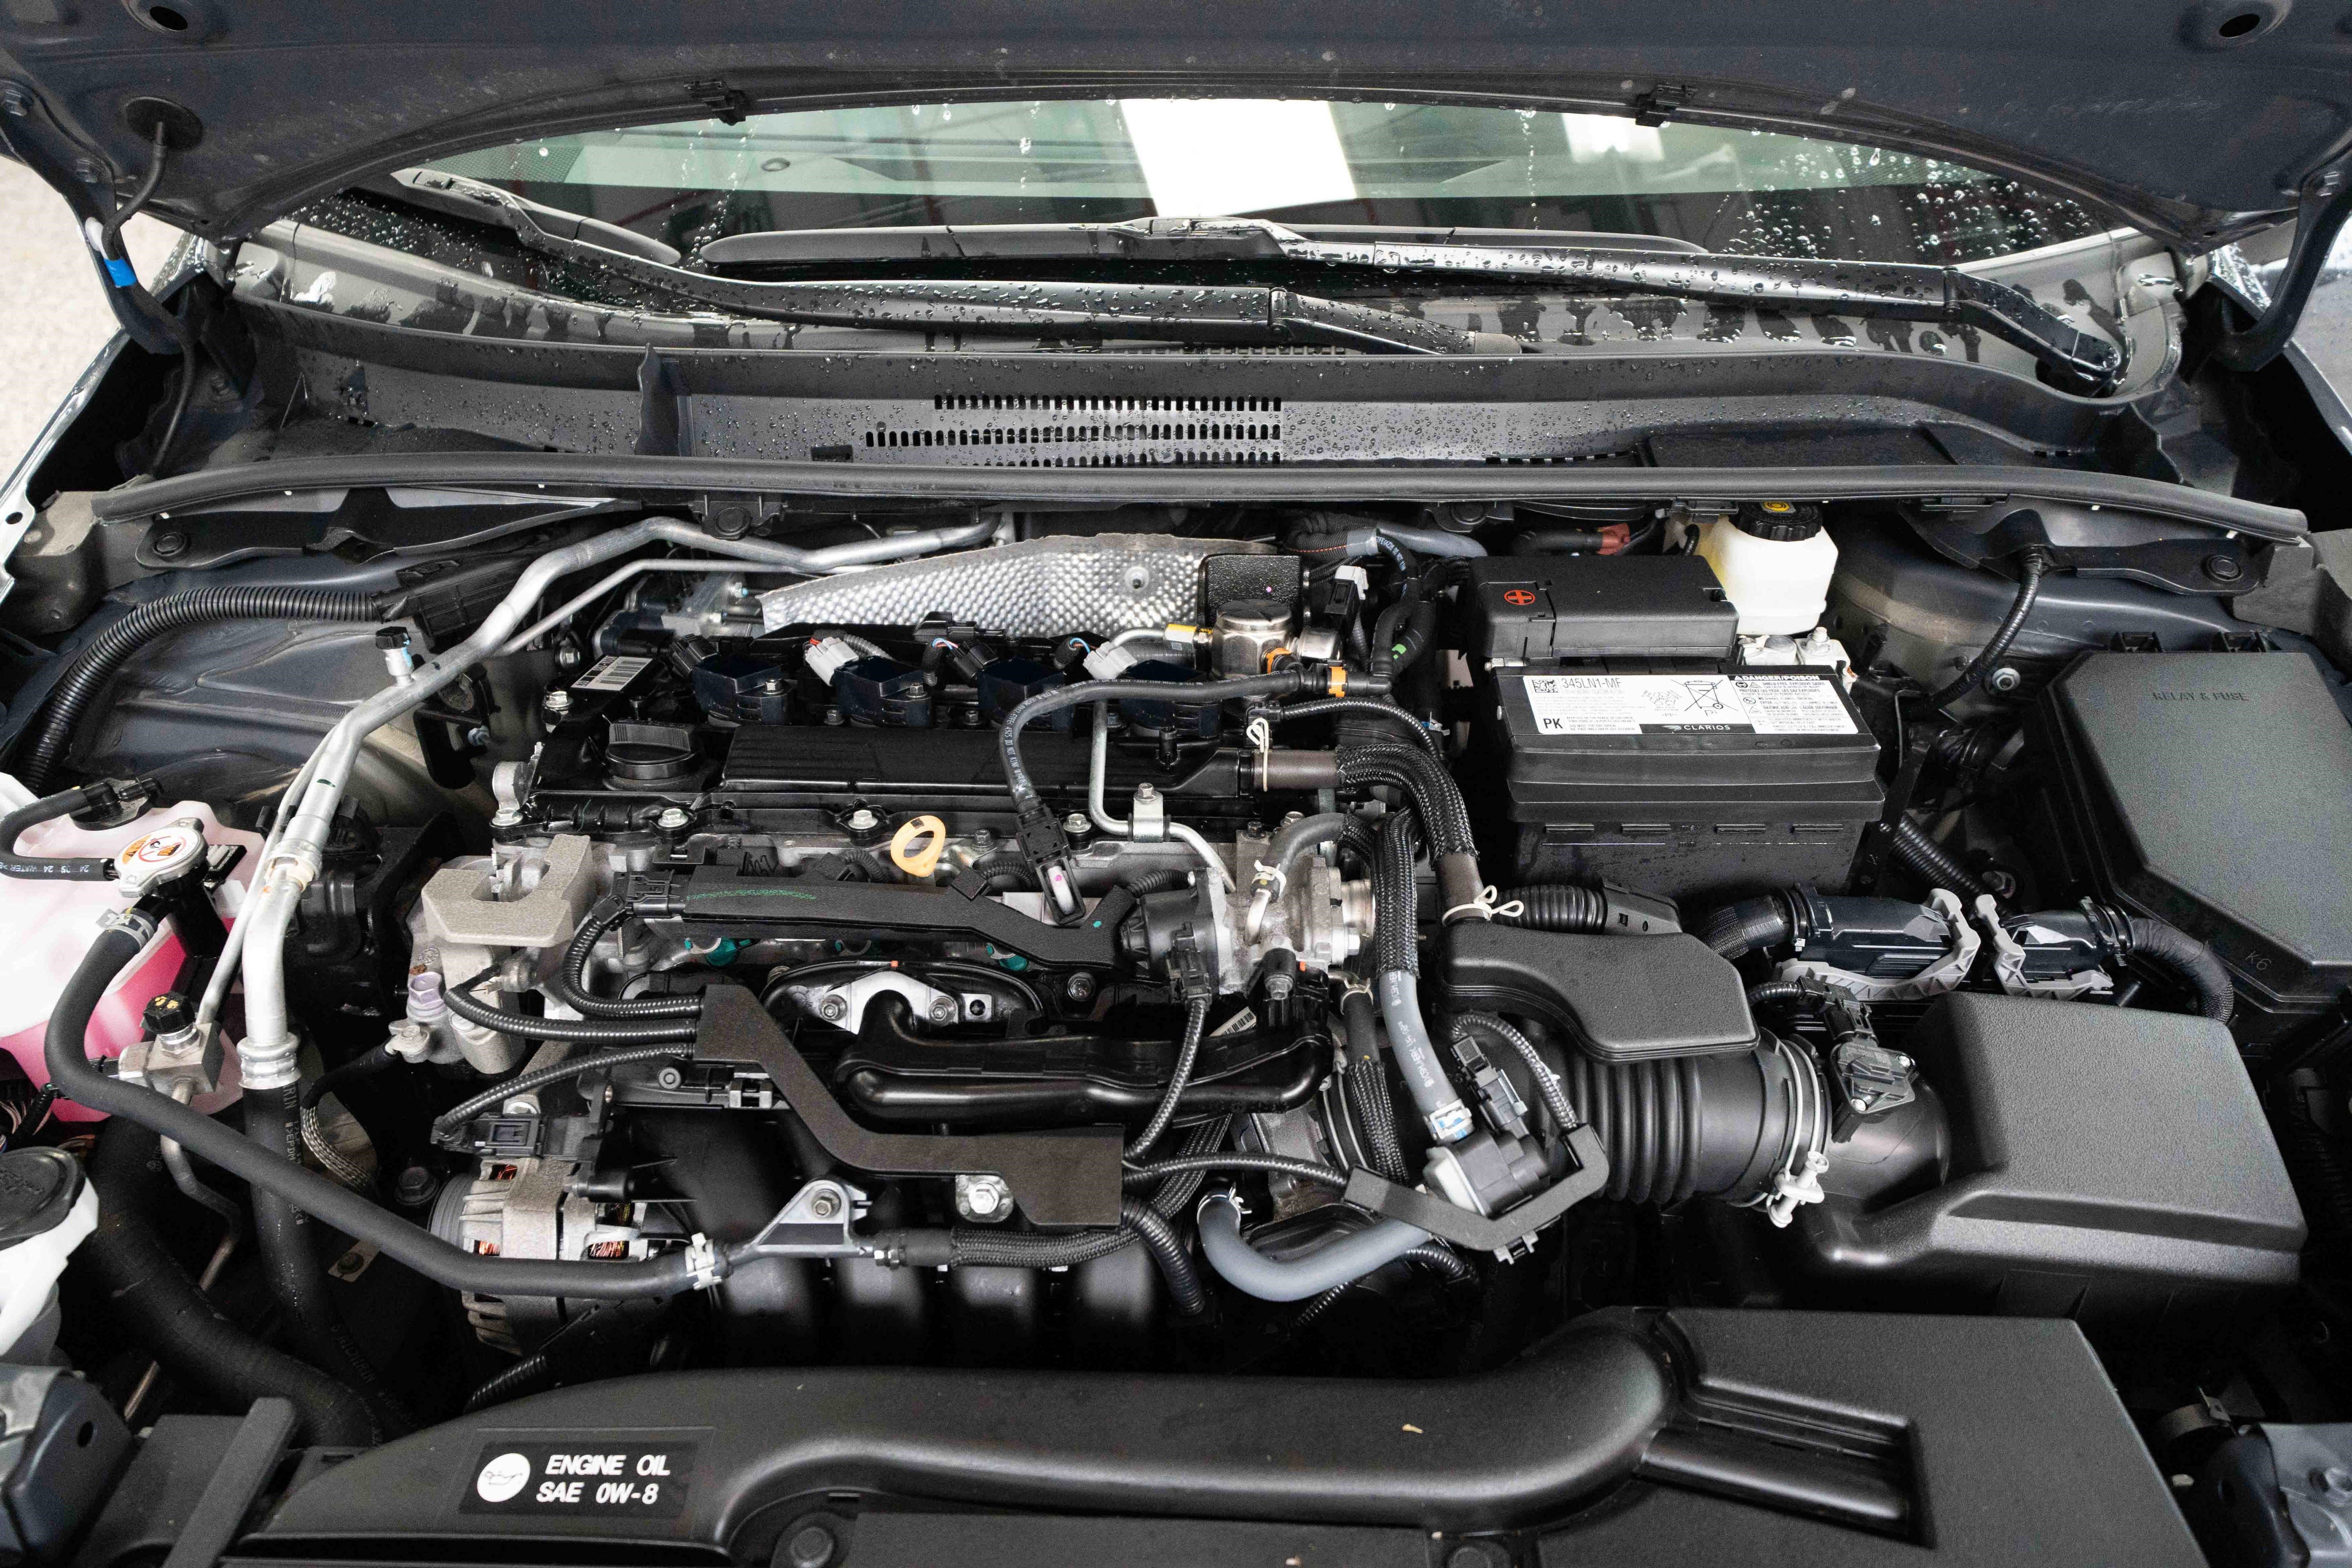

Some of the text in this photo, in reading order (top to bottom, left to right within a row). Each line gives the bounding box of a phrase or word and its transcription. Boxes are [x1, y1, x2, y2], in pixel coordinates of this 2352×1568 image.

[1561, 678, 1621, 688] 345LN1-MF
[2153, 692, 2195, 701] RELAY
[2212, 692, 2250, 701] FUSE
[1544, 718, 1564, 729] PK
[44, 865, 54, 873] 24
[545, 1454, 671, 1477] ENGINE OIL
[536, 1481, 659, 1505] SAE 0W-8
